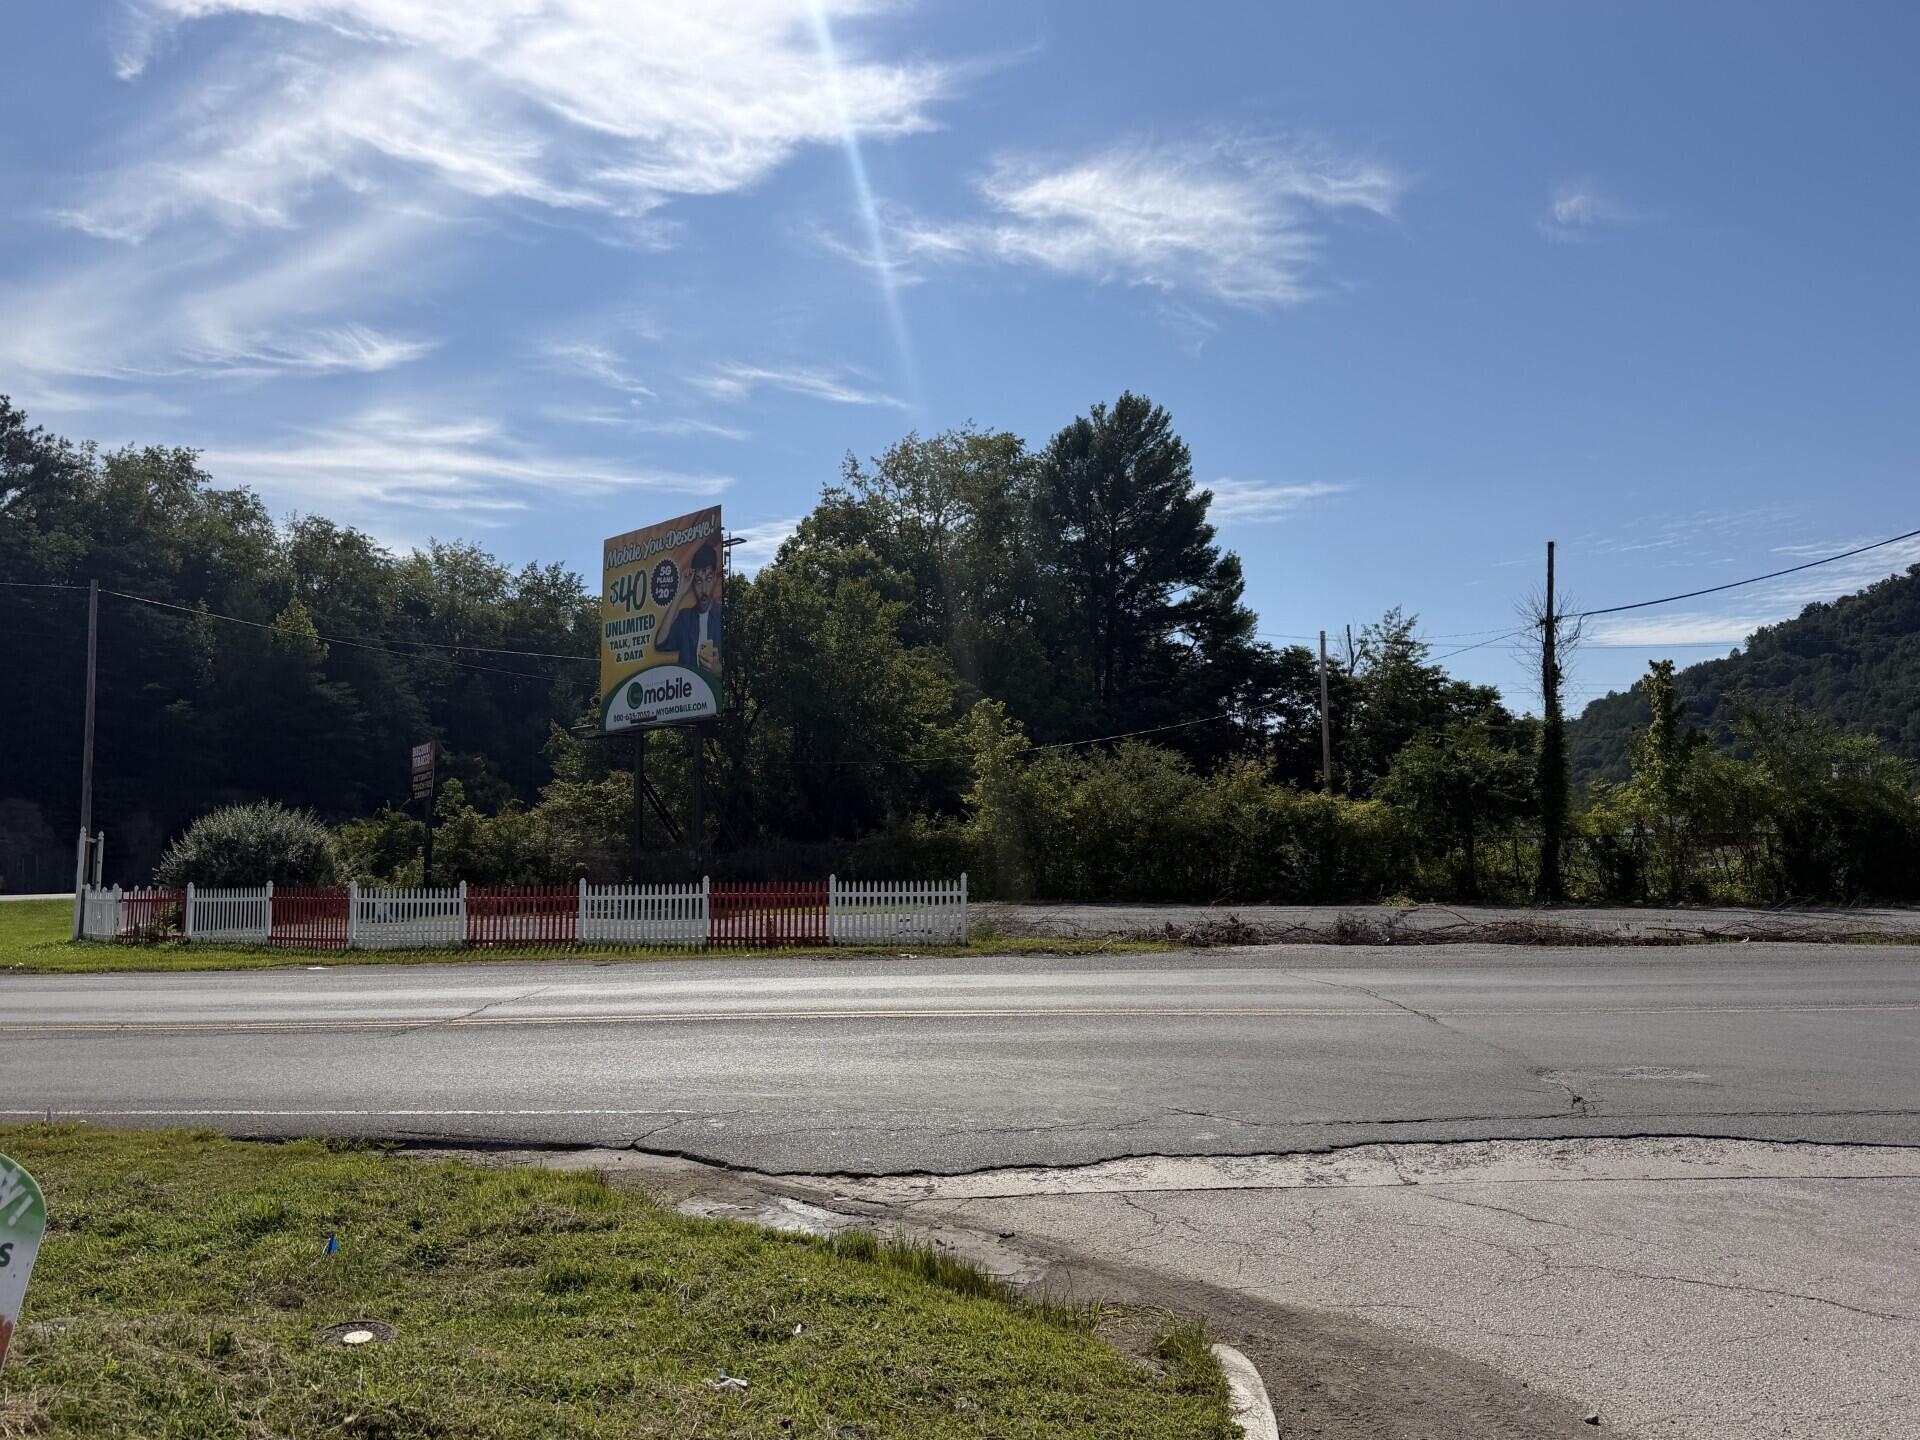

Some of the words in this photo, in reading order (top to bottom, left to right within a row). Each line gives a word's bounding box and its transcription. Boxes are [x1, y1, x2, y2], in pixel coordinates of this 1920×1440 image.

[606, 546, 641, 570] Mobile
[643, 537, 665, 560] You
[665, 513, 716, 549] Deserve!
[659, 565, 672, 576] 5G
[656, 576, 674, 584] PLANS
[610, 569, 647, 612] $40
[655, 587, 670, 599] $20
[605, 614, 656, 639] UNLIMITED
[610, 638, 631, 651] TALK,
[632, 634, 651, 646] TEXT
[616, 653, 622, 662] &
[623, 649, 644, 661] DATA
[644, 677, 692, 704] mobile
[656, 701, 708, 716] MYGMOBILE.COM
